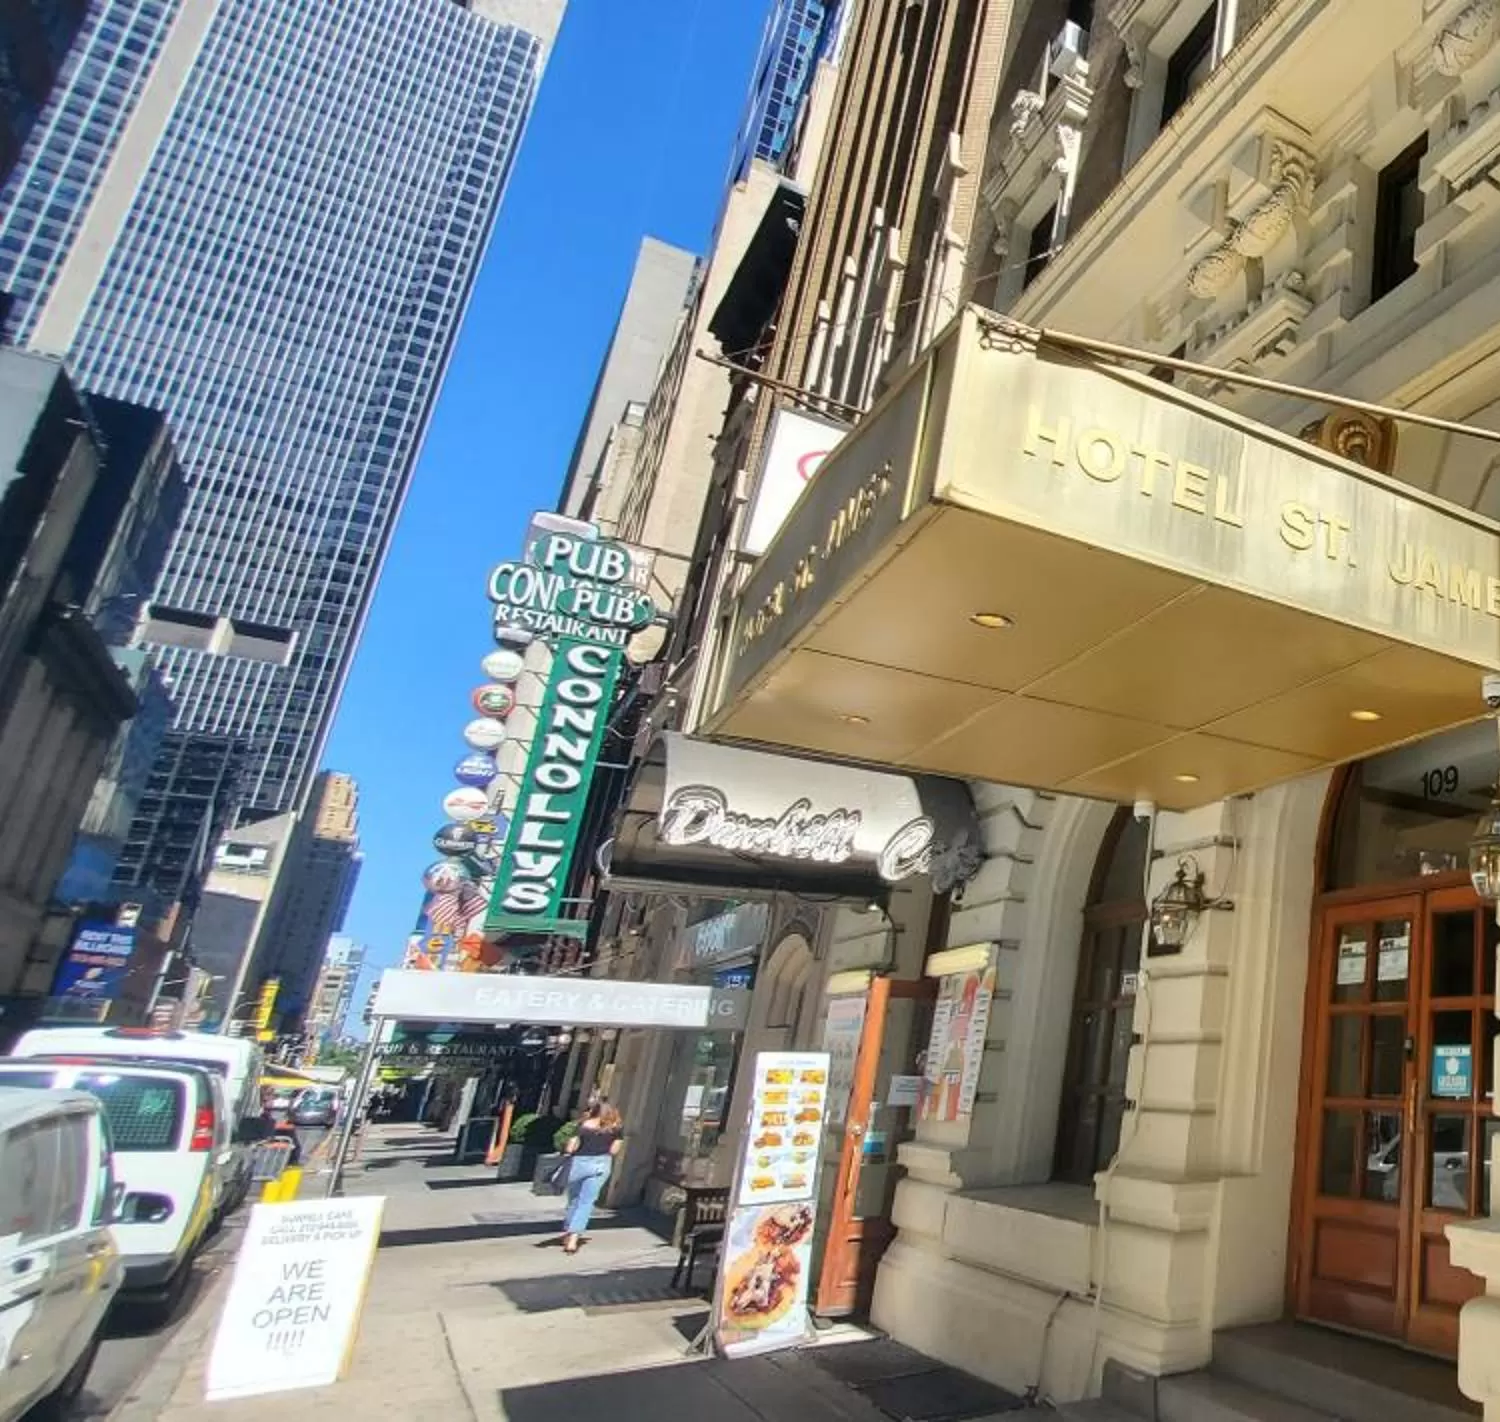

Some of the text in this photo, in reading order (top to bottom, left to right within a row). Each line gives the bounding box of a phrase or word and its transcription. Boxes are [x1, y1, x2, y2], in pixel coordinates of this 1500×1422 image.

[1022, 403, 1244, 529] HOTEL
[1278, 500, 1358, 569] ST.
[545, 535, 626, 581] PUB
[572, 589, 635, 624] PUB
[1420, 765, 1459, 801] 109
[476, 986, 735, 1018] EATERY & CATERING
[283, 1258, 329, 1281] WE
[266, 1281, 328, 1305] ARE
[252, 1303, 331, 1329] OPEN
